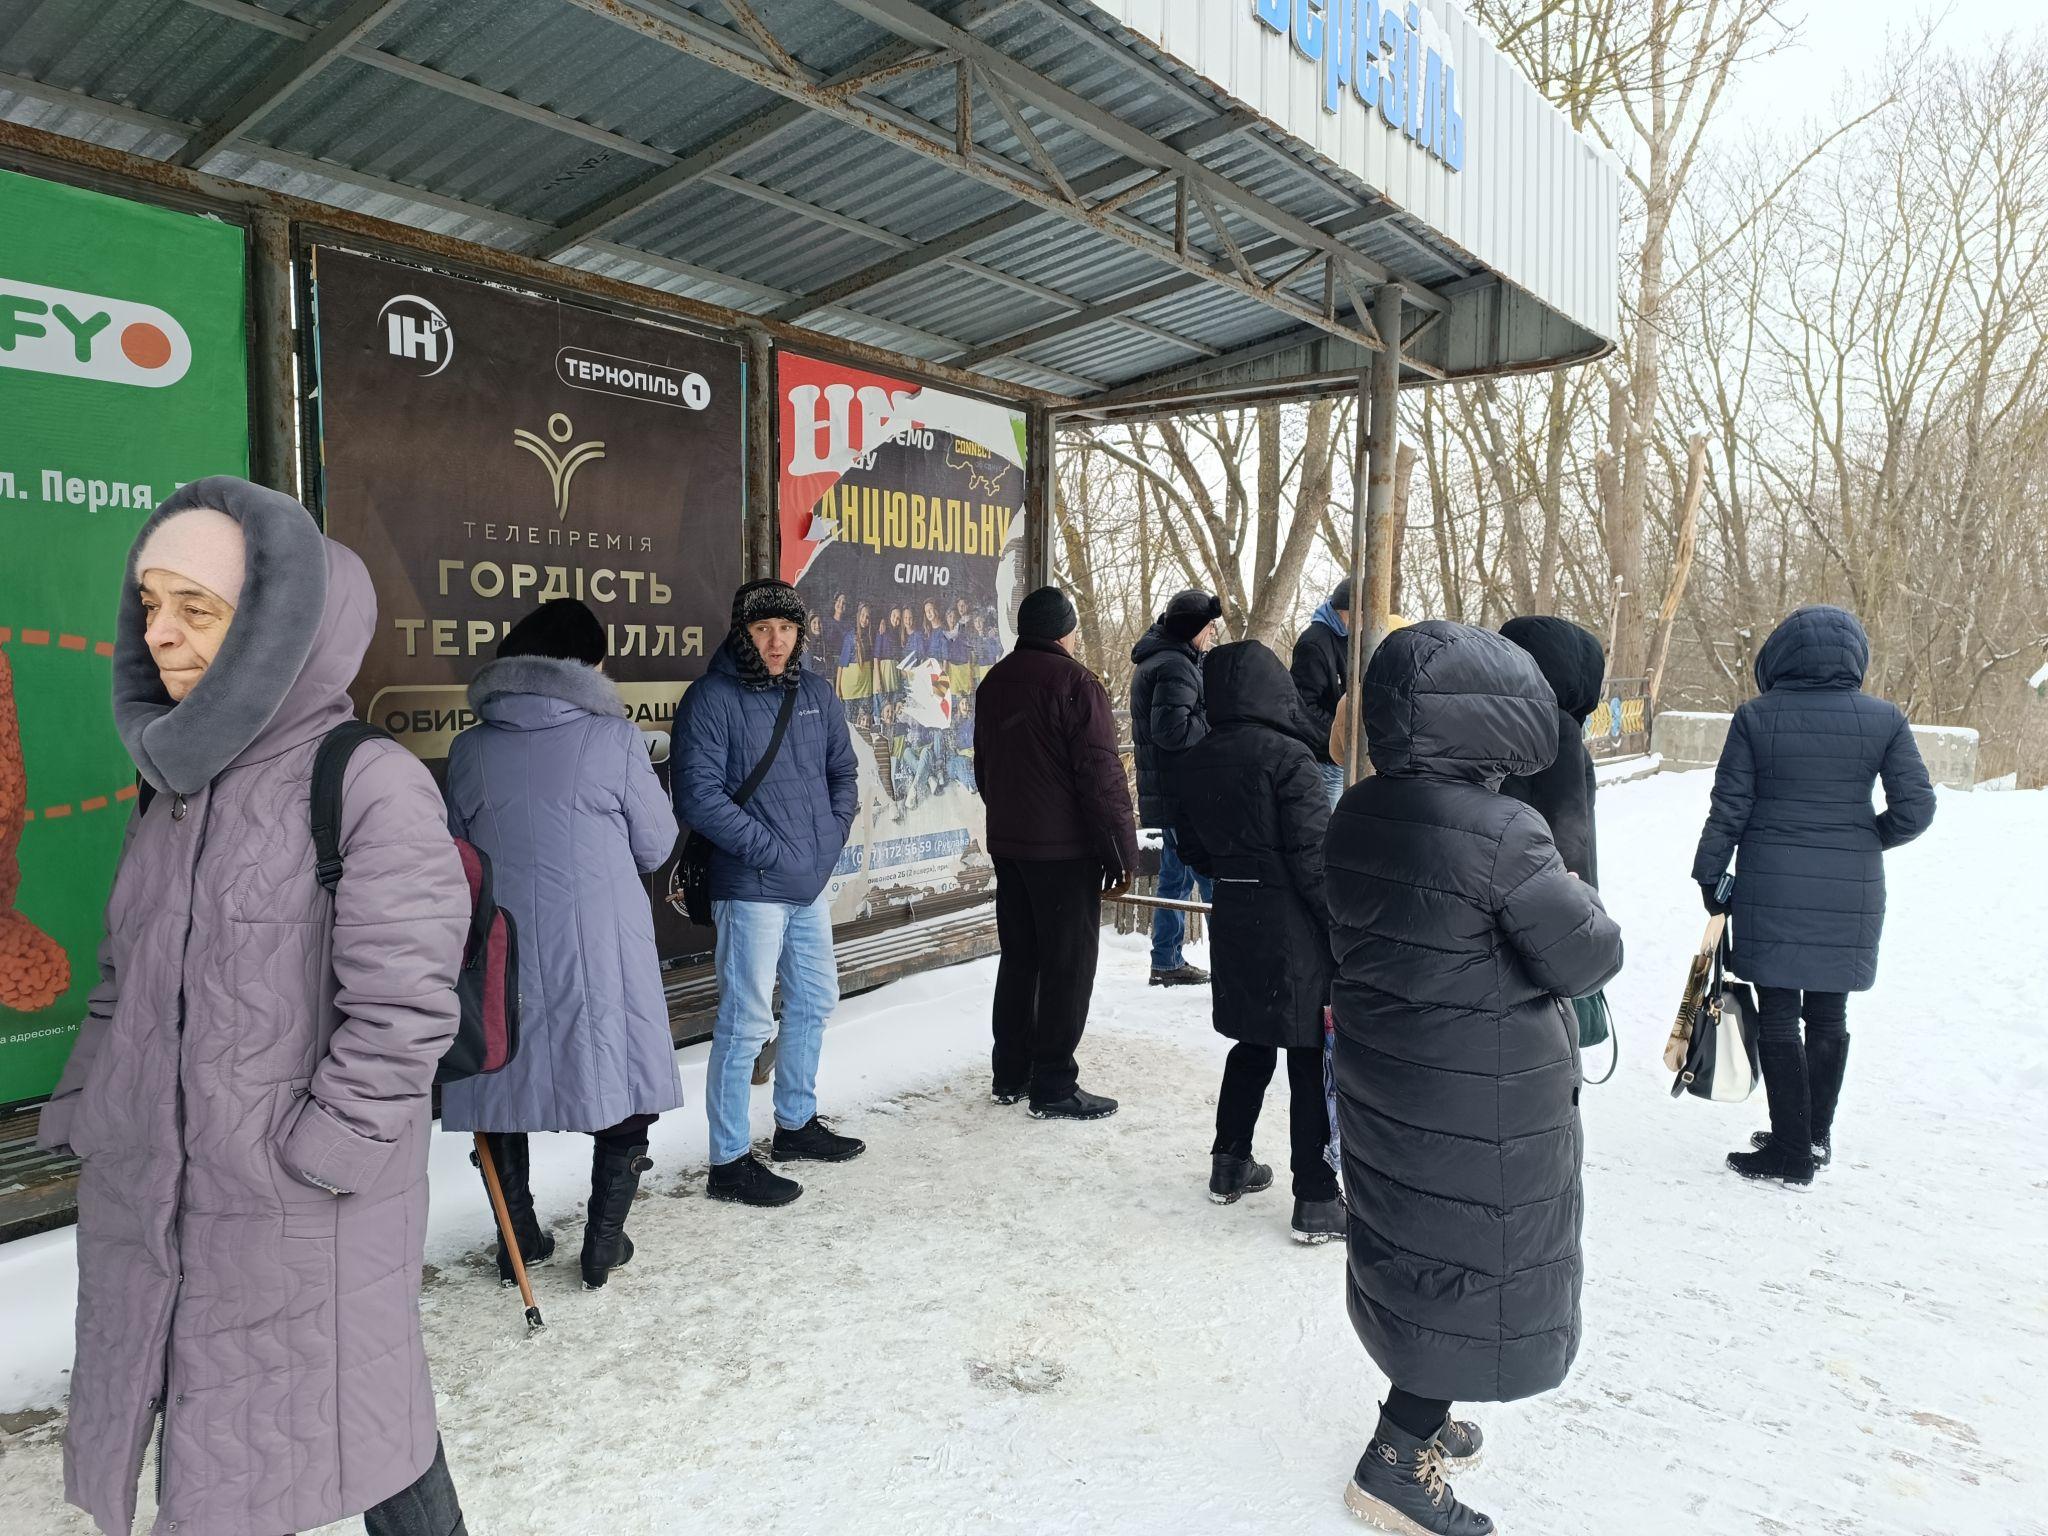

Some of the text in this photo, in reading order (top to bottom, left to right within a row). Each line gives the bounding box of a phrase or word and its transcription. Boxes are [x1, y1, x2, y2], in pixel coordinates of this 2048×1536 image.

[565, 357, 679, 397] ТЕРНОПІЛЬ
[463, 521, 653, 552] ТЕЛЕПРЕМІЯ
[438, 559, 673, 605] ГОРДІСТЬ
[894, 562, 950, 586] СІМ'Ю
[394, 618, 704, 657] ТЕРІЛЛЯ
[920, 840, 932, 853] 59
[10, 1026, 64, 1042] адресою:
[67, 1024, 79, 1032] м.
